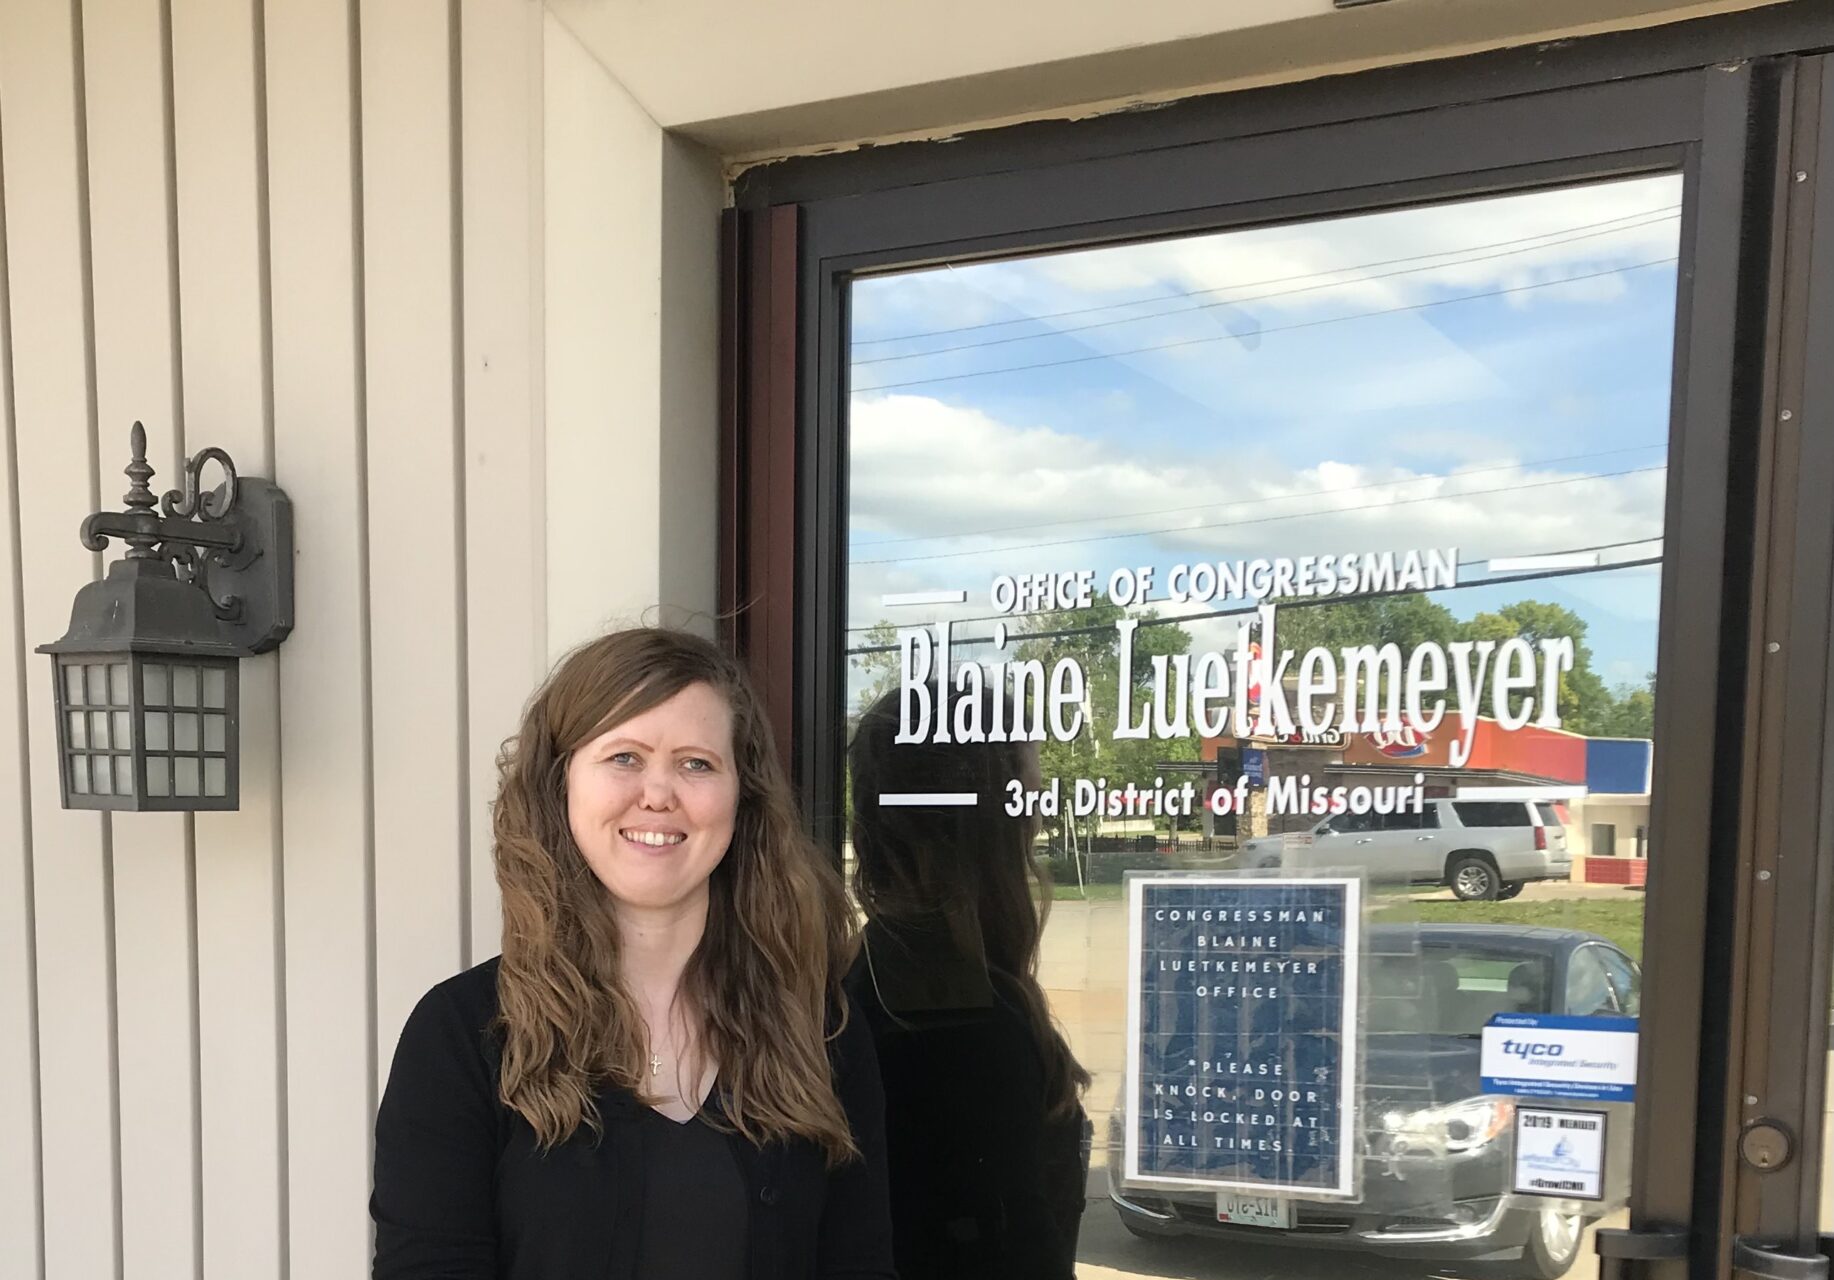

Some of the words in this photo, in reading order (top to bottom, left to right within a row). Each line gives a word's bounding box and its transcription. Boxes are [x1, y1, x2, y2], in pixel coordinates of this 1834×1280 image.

[991, 570, 1095, 613] OFFICE
[1108, 566, 1154, 607] OF
[1168, 547, 1459, 602] CONGRESSMAN
[894, 621, 1086, 744] Blaine
[1113, 603, 1574, 767] Luetkemeyer
[1004, 778, 1059, 817] 3rd
[1074, 777, 1195, 817] District
[1211, 774, 1250, 816] of
[1266, 773, 1425, 815] Missouri
[1155, 910, 1323, 922] CONGRESSMAN
[1197, 936, 1277, 948] BLAINE
[1160, 960, 1317, 974] LUETKEMEYER
[1196, 986, 1277, 998] OFFICE
[1502, 1039, 1564, 1059] tyco
[1155, 1084, 1237, 1100] KNOCK,
[1255, 1089, 1317, 1102] DOOR
[1154, 1109, 1173, 1121] IS
[1191, 1111, 1275, 1125] LOCKED
[1292, 1117, 1318, 1128] AT
[1163, 1134, 1198, 1146] ALL
